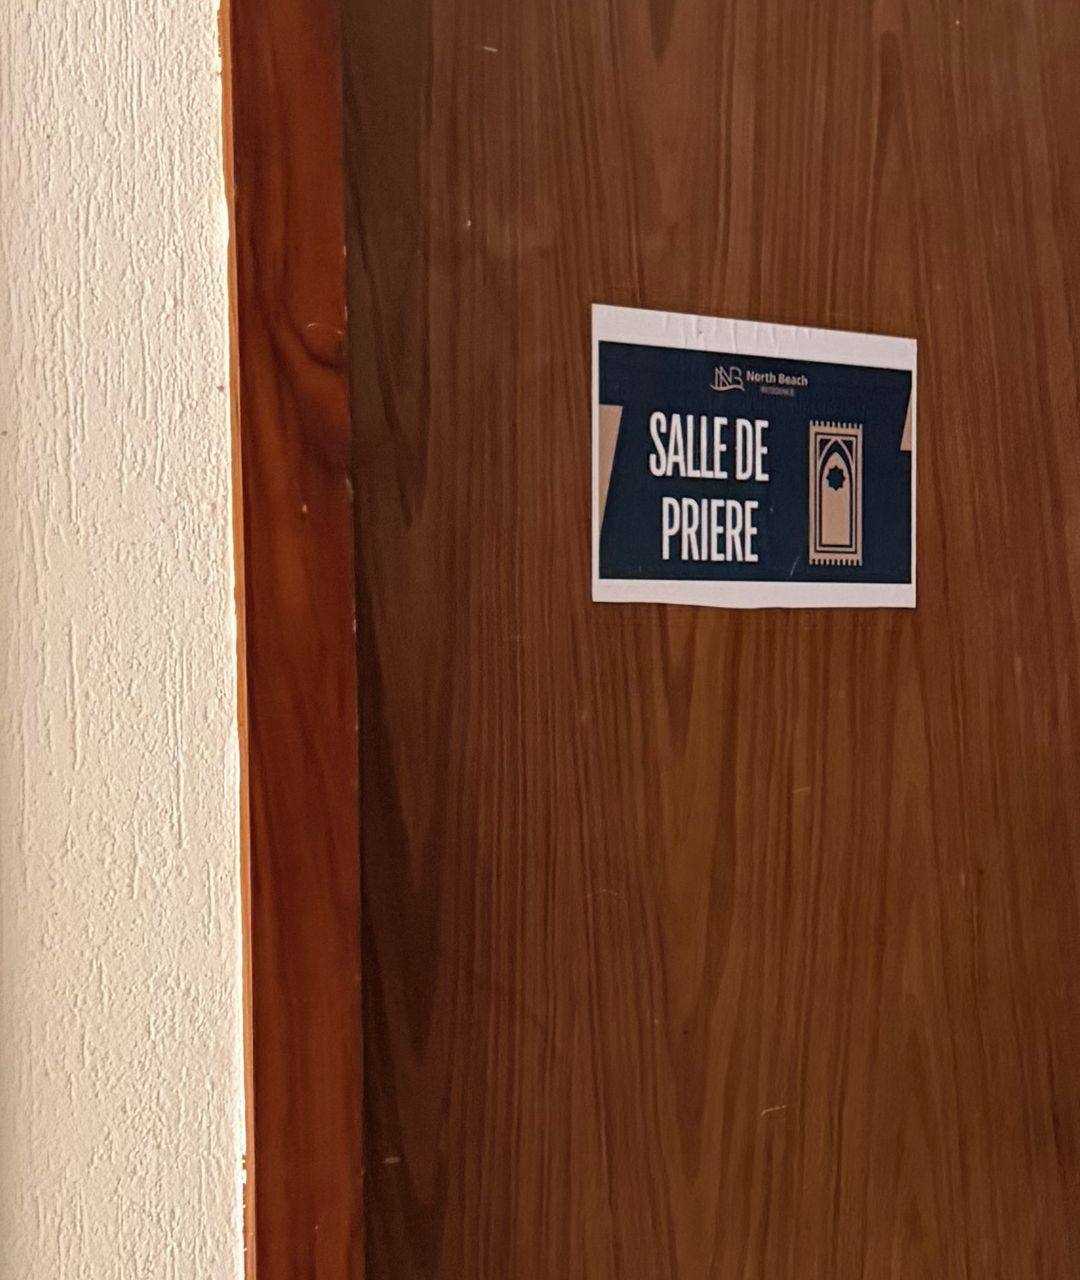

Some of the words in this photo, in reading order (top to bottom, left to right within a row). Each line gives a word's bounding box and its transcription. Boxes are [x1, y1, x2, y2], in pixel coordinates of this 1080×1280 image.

[746, 370, 776, 384] North
[778, 373, 808, 387] Beach
[649, 411, 728, 480] SALLE
[735, 418, 769, 482] DE
[662, 497, 759, 563] PRIERE
